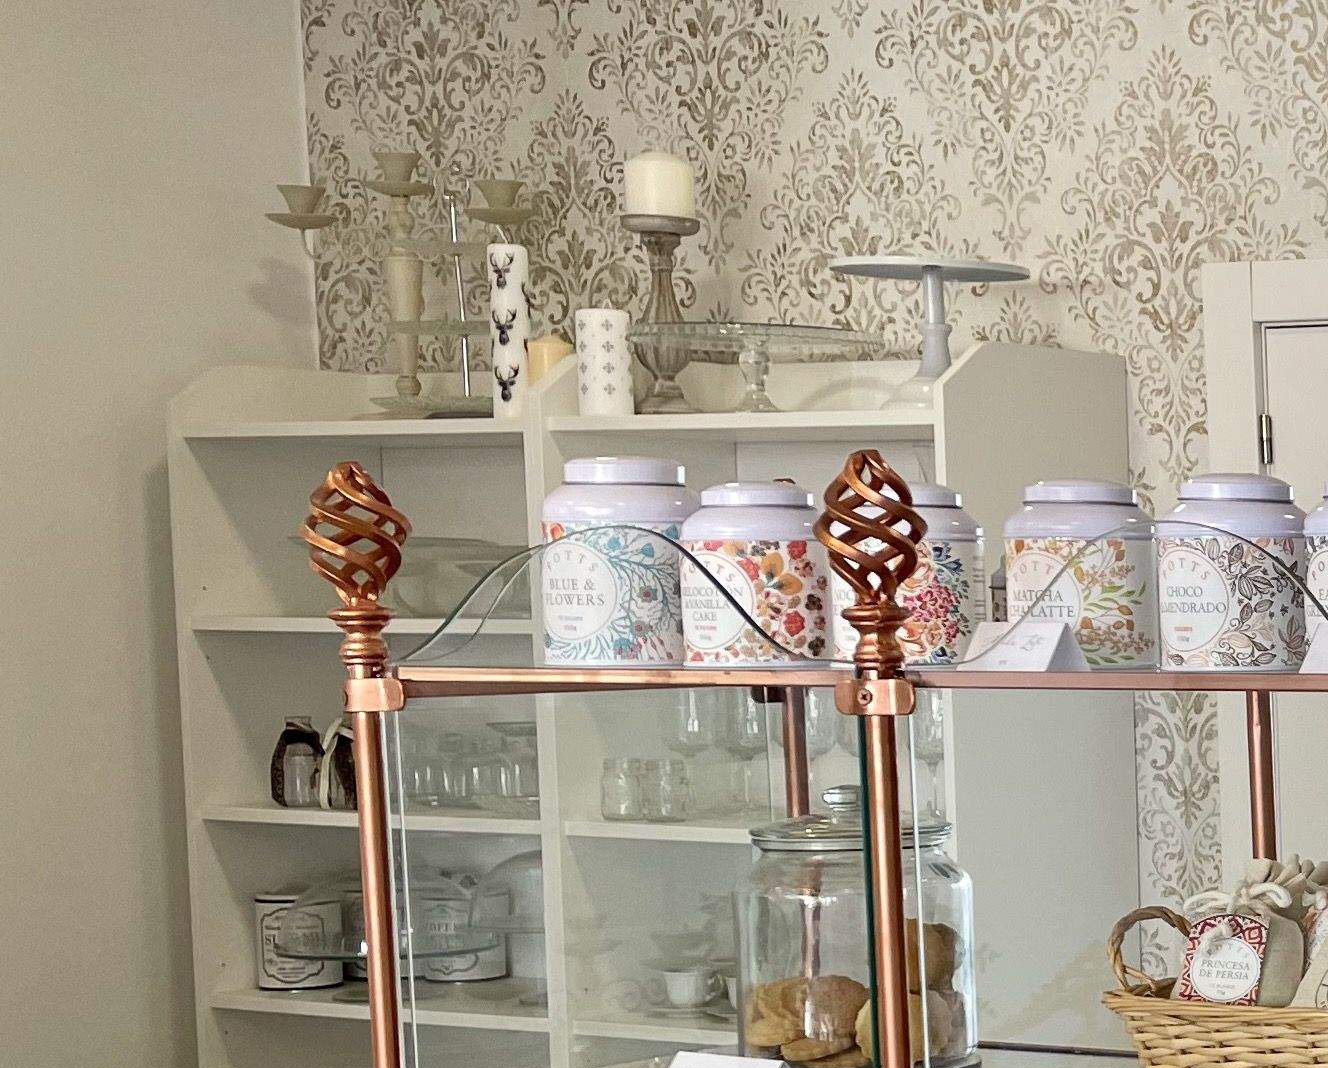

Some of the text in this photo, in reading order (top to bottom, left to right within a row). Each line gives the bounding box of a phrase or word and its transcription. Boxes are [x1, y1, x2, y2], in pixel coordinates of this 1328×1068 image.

[549, 577, 597, 591] BLUE &
[1167, 585, 1203, 597] CHOCO
[693, 611, 718, 621] CAKE
[1200, 960, 1250, 971] PRINCESA
[1199, 968, 1249, 980] DE PERSIA
